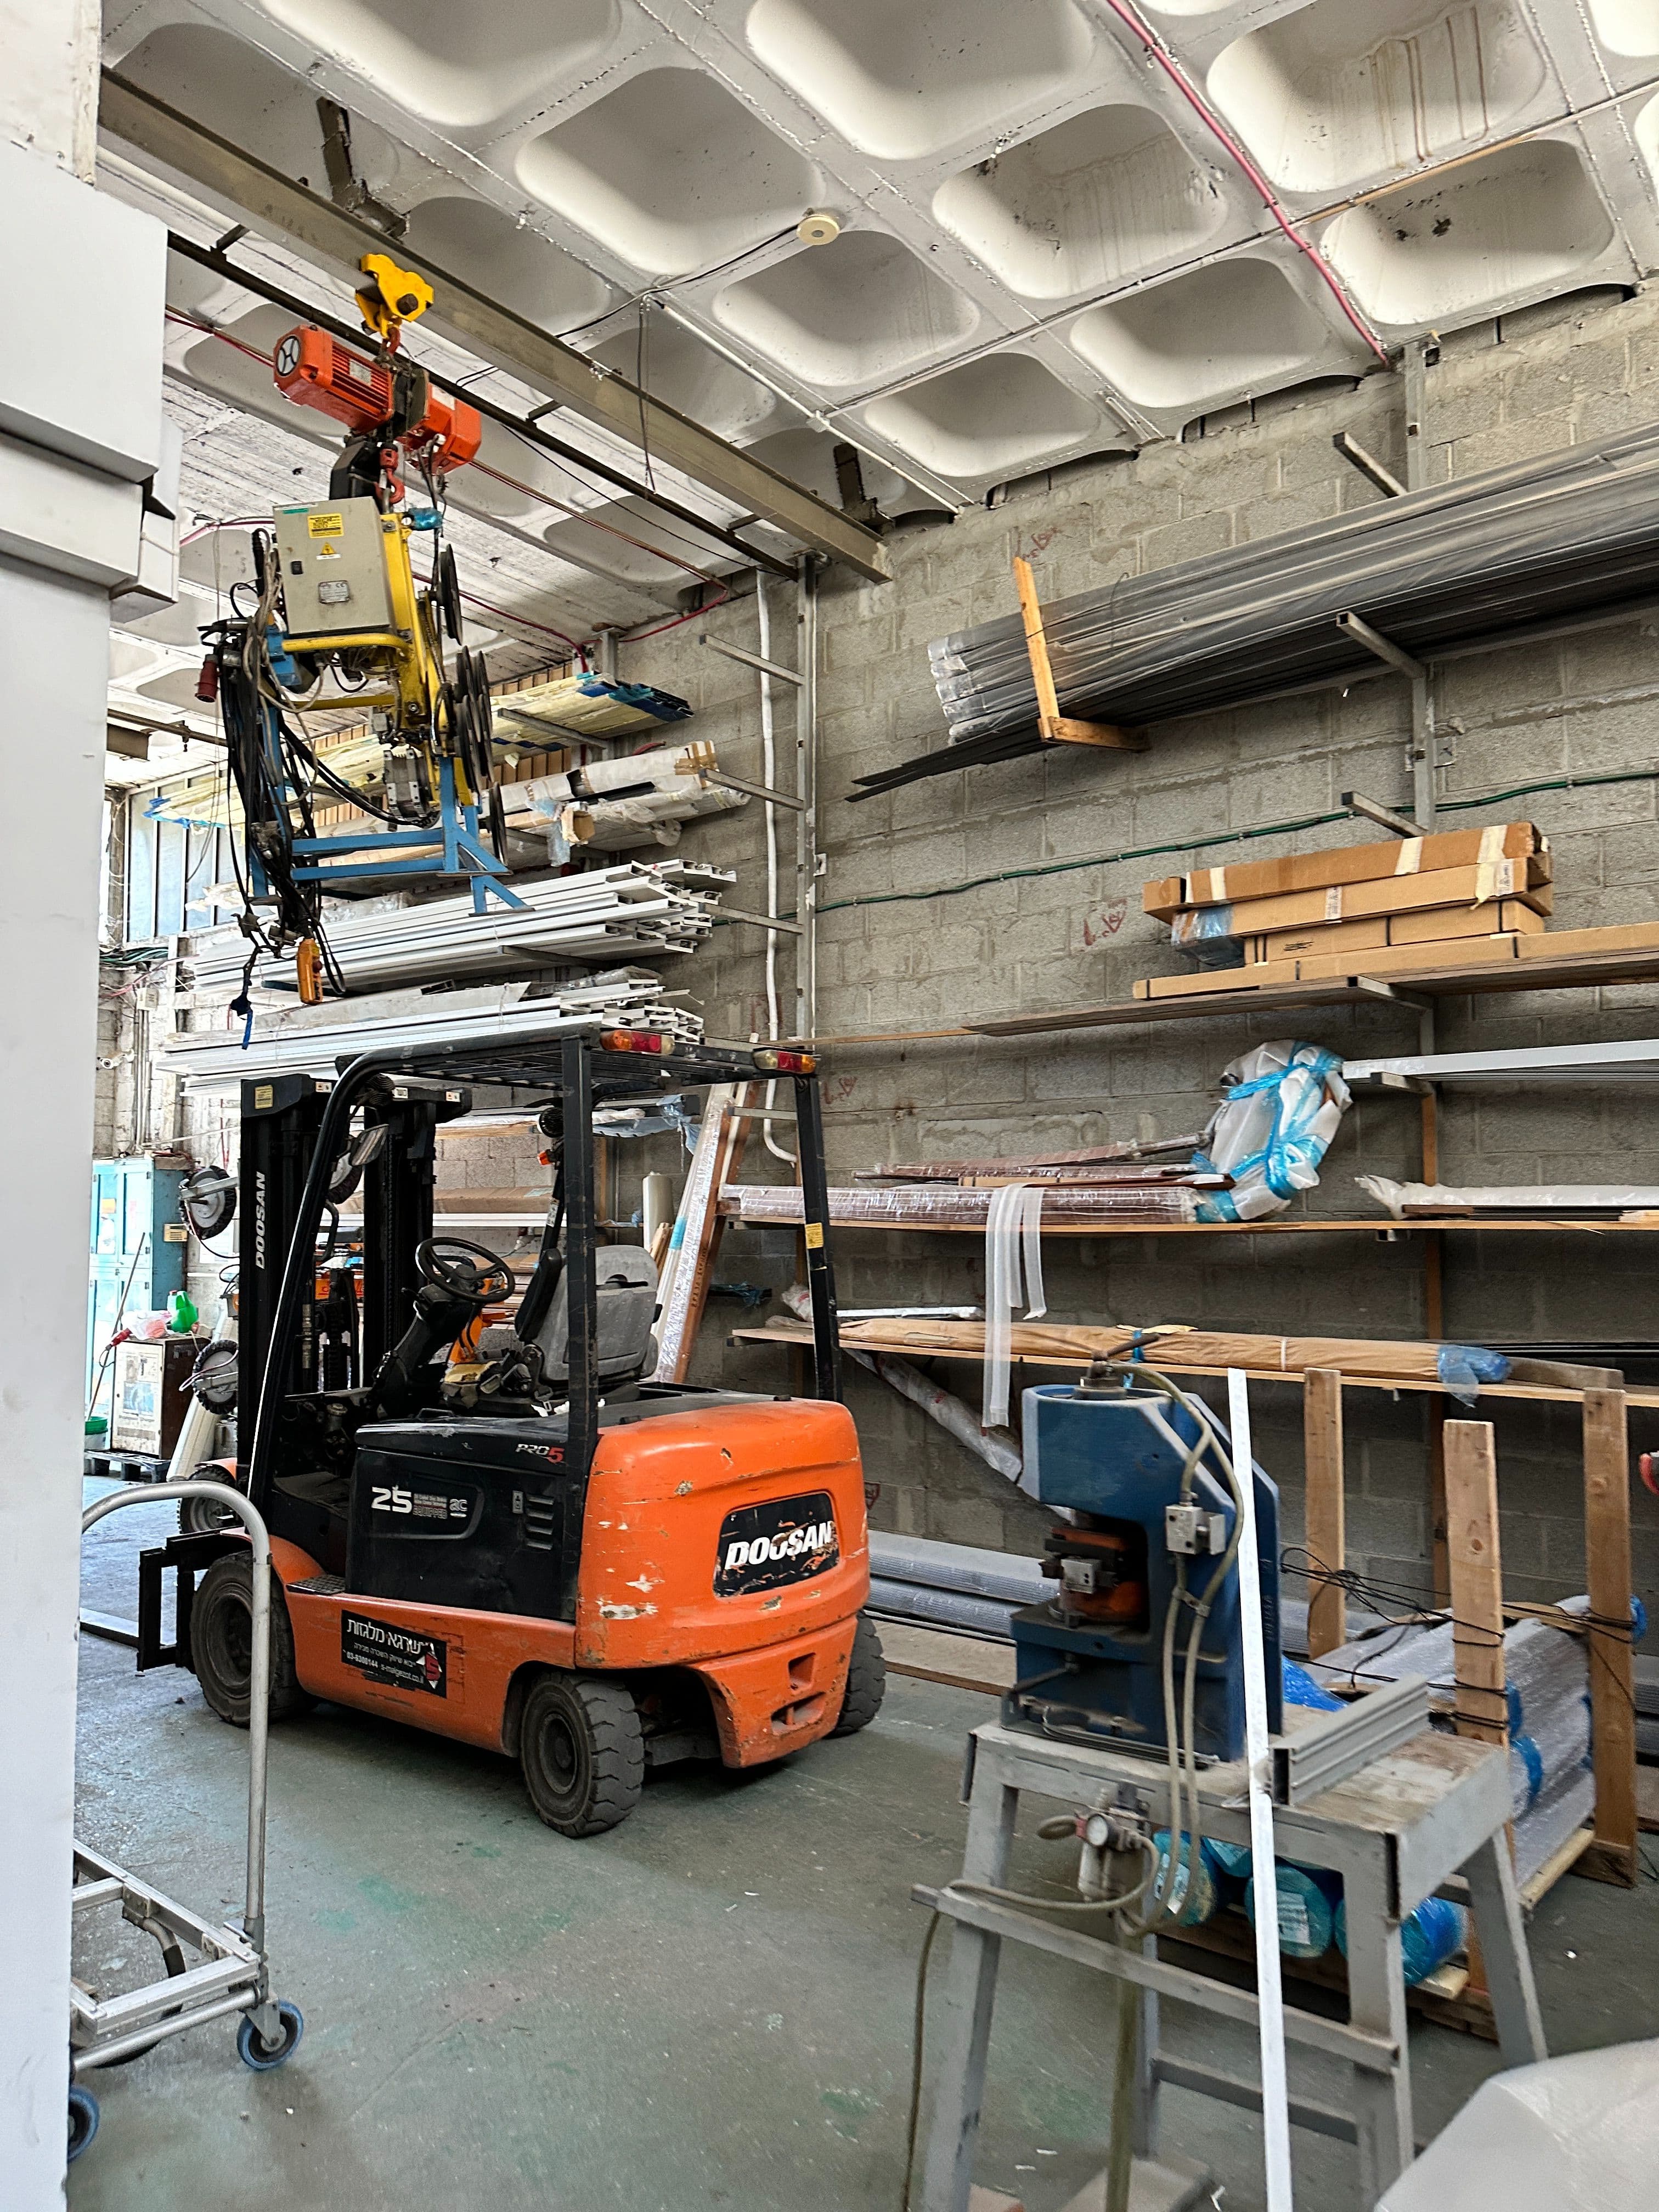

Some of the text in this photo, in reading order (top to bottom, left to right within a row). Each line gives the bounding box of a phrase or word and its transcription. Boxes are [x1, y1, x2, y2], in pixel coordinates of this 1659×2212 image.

[256, 1171, 266, 1269] DOOSAN
[371, 1486, 413, 1514] 25
[724, 1521, 834, 1570] DOOSAN
[346, 1618, 385, 1643] מלגזות
